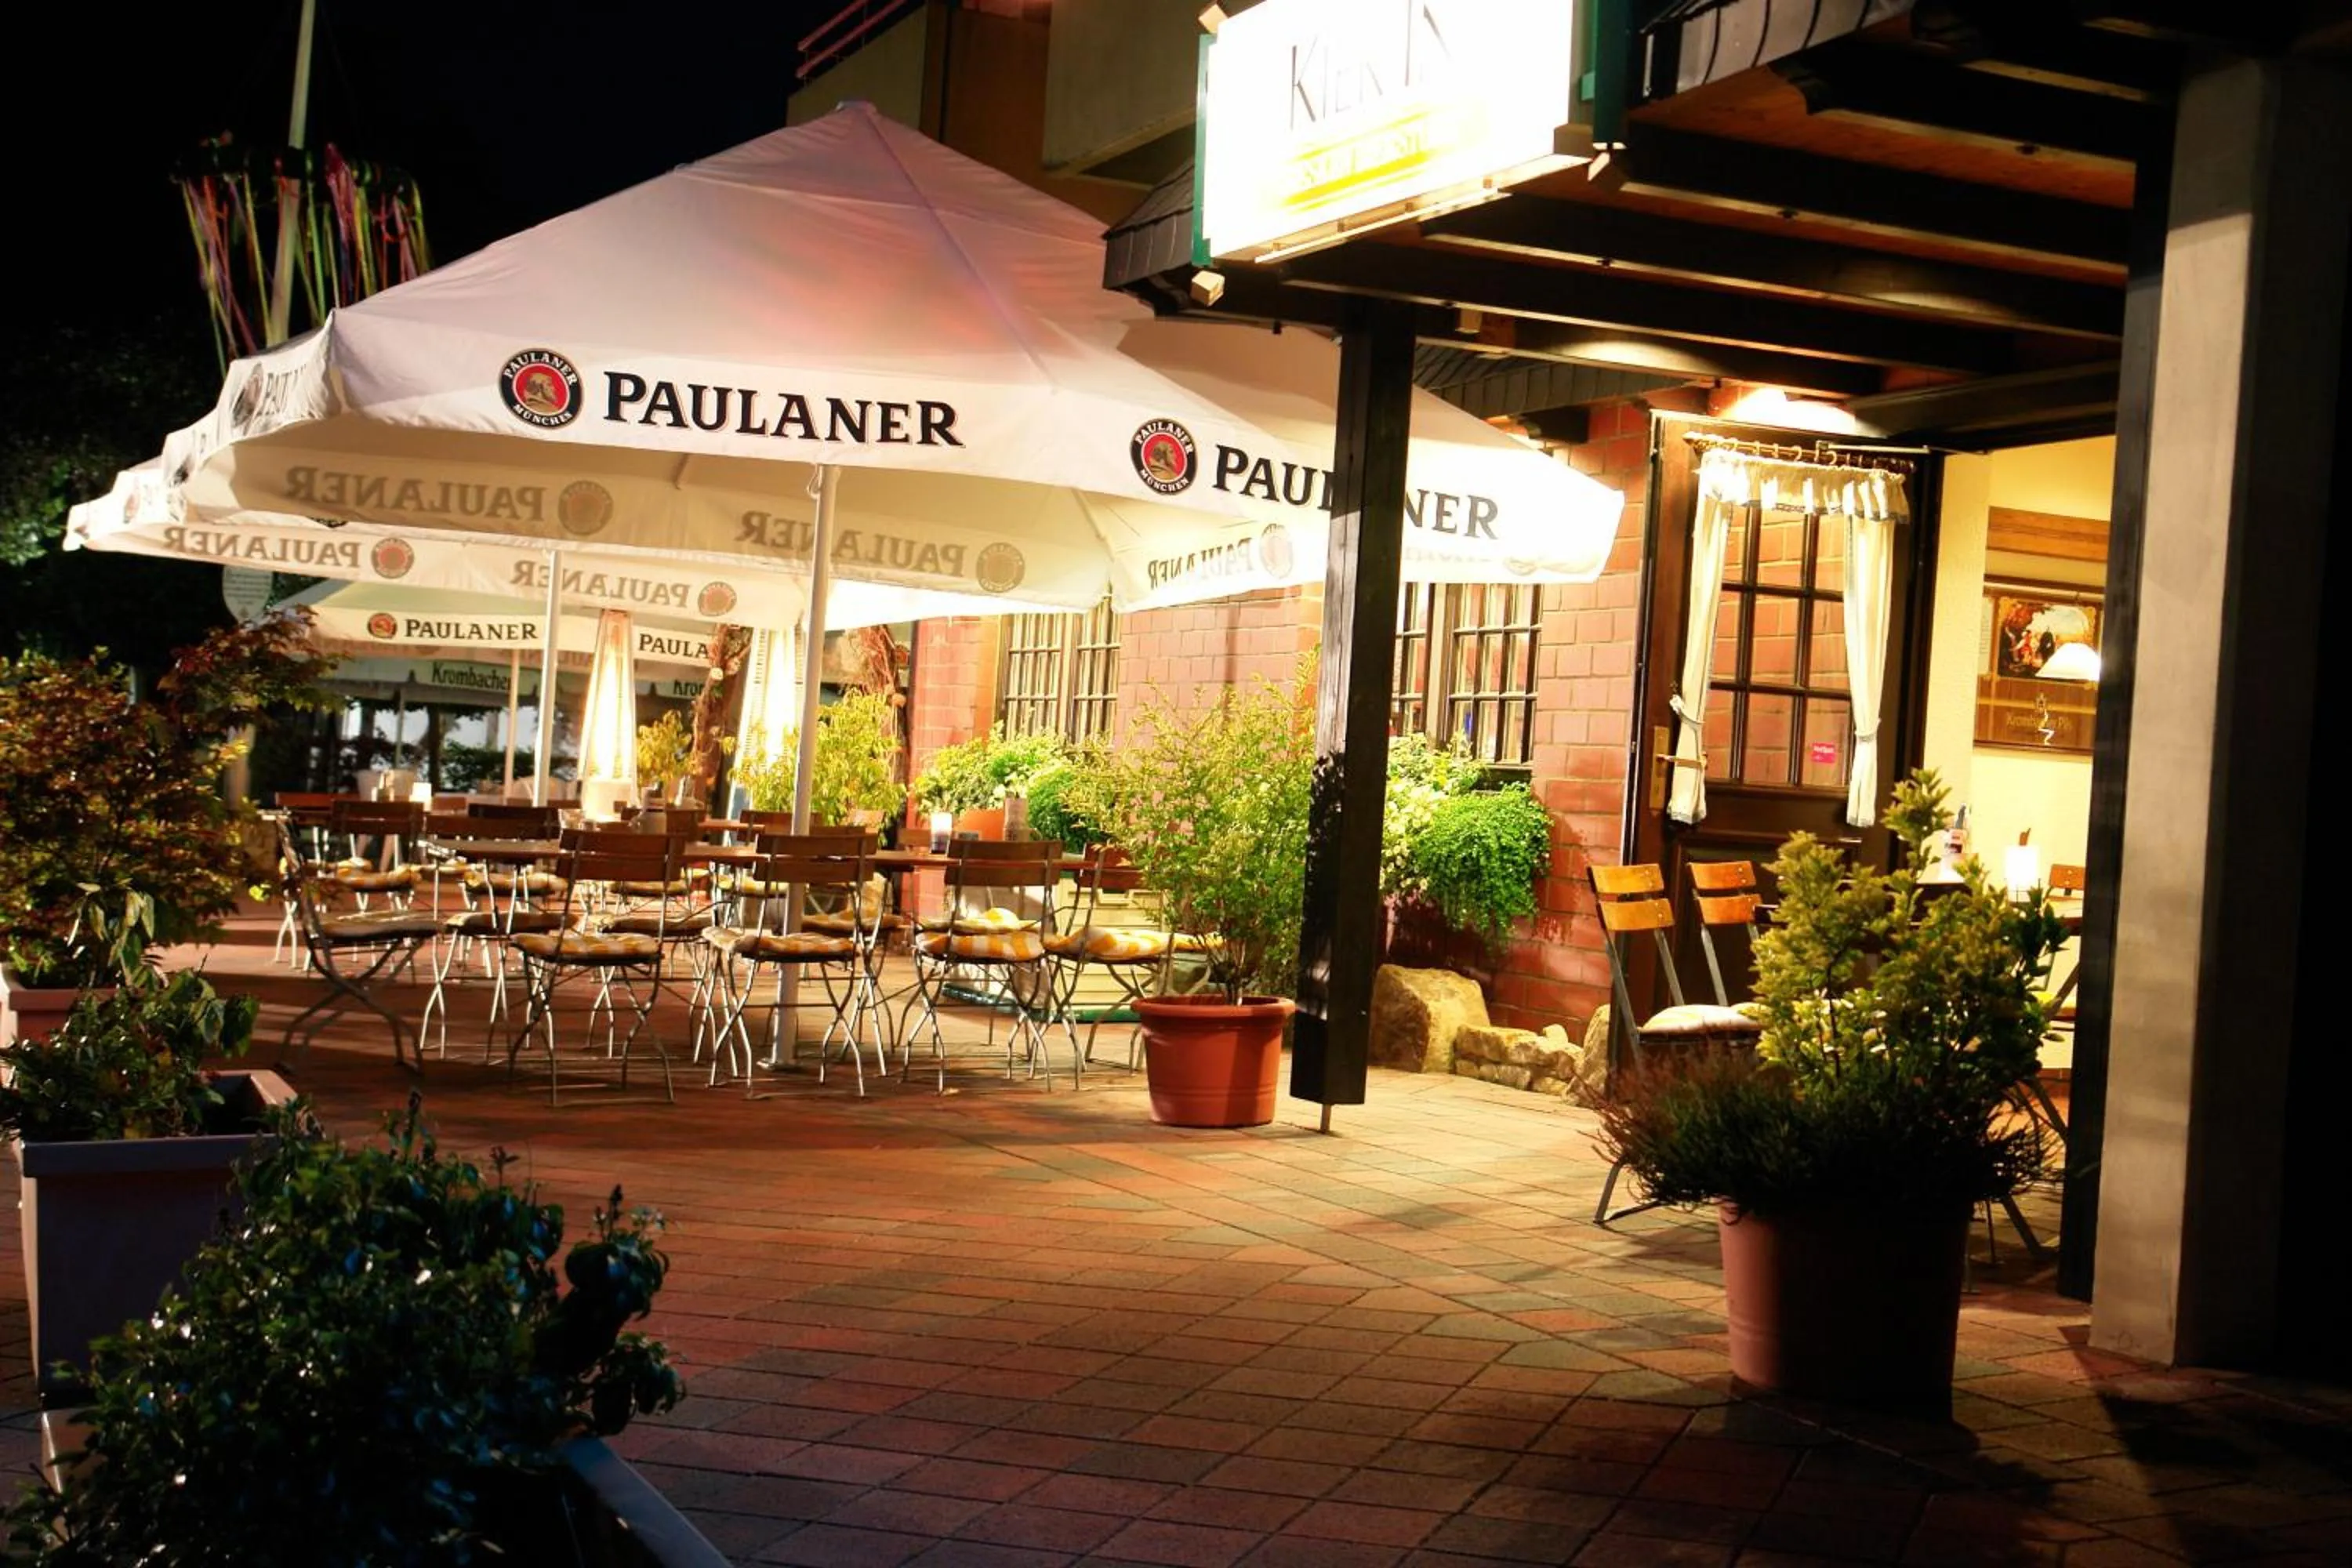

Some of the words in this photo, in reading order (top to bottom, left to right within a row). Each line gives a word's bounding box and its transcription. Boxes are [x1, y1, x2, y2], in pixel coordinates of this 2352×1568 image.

[503, 352, 578, 386] PAULANER
[604, 371, 965, 447] PAULANER
[1212, 444, 1498, 539] PAULNER
[404, 618, 539, 641] PAULANER
[638, 633, 709, 659] PAULA
